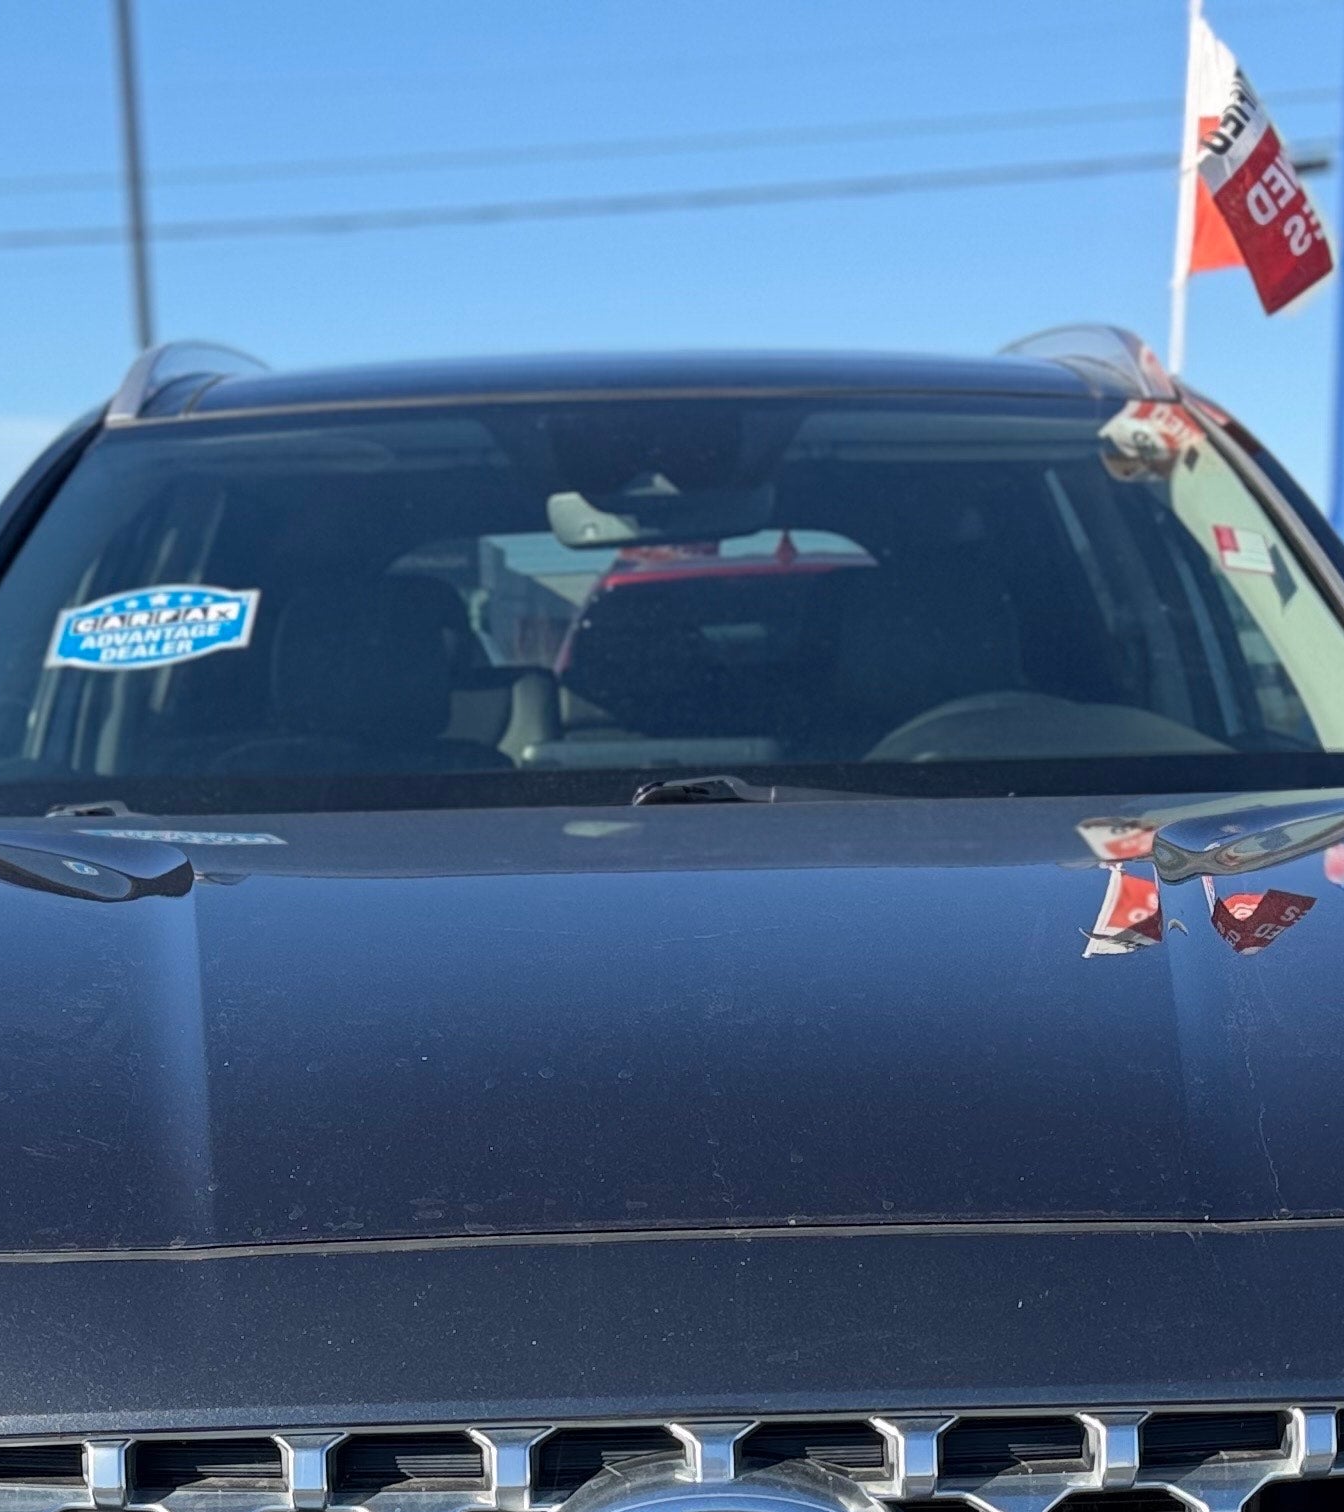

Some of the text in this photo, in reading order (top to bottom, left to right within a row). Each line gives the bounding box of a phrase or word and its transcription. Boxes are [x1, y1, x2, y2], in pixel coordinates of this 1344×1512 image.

[73, 602, 241, 634] CARFAX
[79, 623, 222, 650] ADVANTAGE
[99, 640, 194, 661] DEALER
